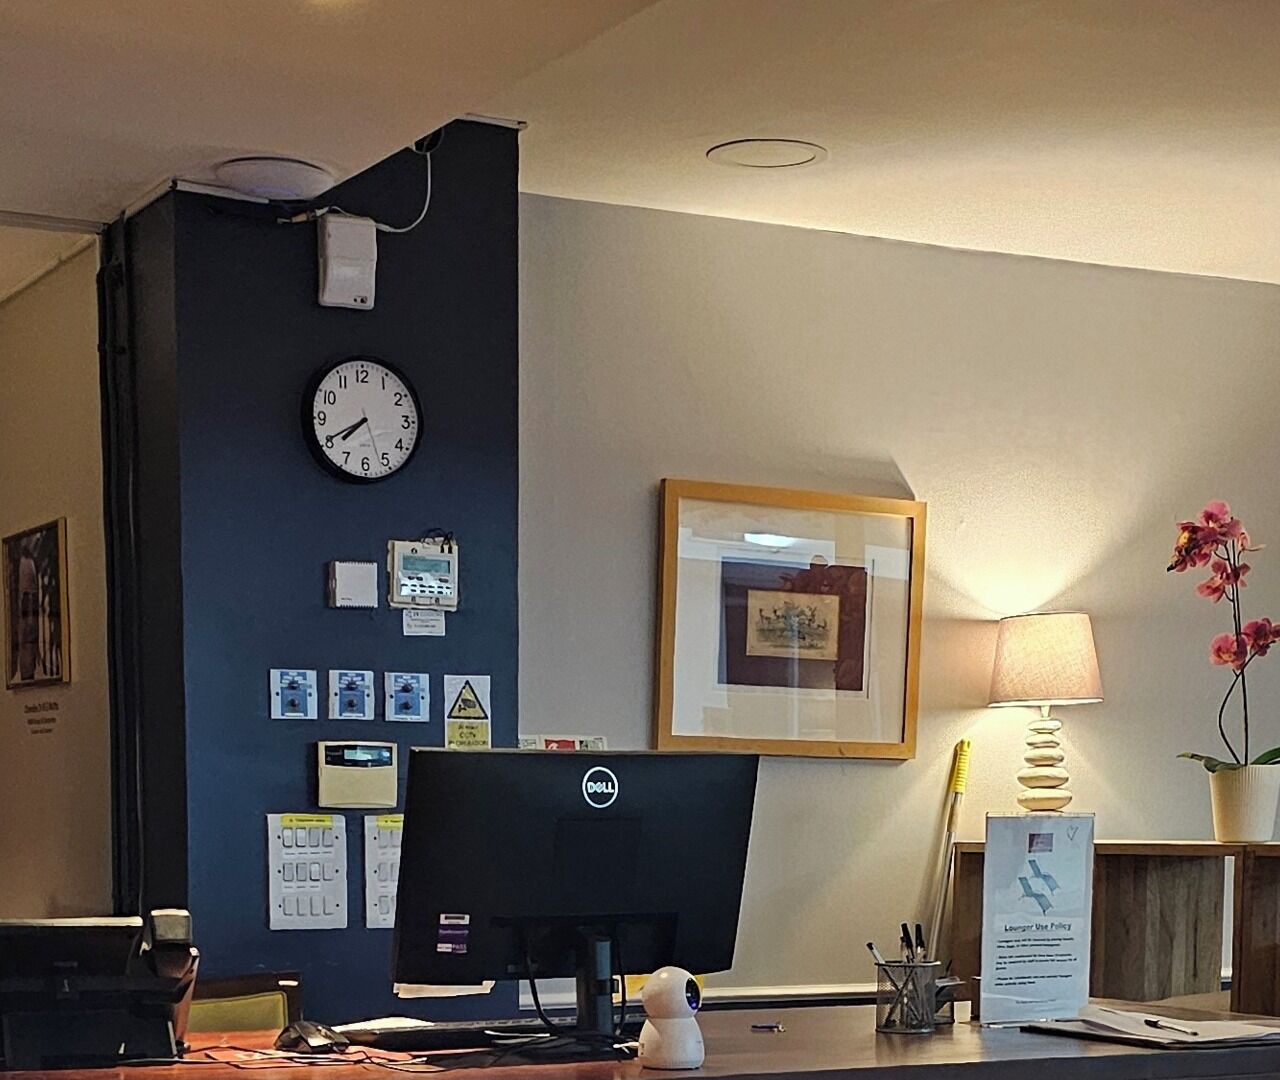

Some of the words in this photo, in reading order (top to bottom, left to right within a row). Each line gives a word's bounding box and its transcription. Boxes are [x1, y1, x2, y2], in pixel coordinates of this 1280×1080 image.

[339, 375, 347, 389] 11
[356, 369, 369, 383] 12
[381, 376, 385, 390] 1
[324, 390, 336, 405] 10
[394, 392, 403, 406] 2
[317, 411, 326, 426] 9
[401, 415, 410, 429] 3
[326, 435, 334, 448] 8
[395, 438, 404, 452] 4
[342, 451, 350, 465] 7
[361, 457, 370, 471] 6
[381, 453, 390, 467] 5
[587, 781, 614, 793] DELL
[1004, 924, 1034, 932] Lounger
[1050, 922, 1072, 931] Policy
